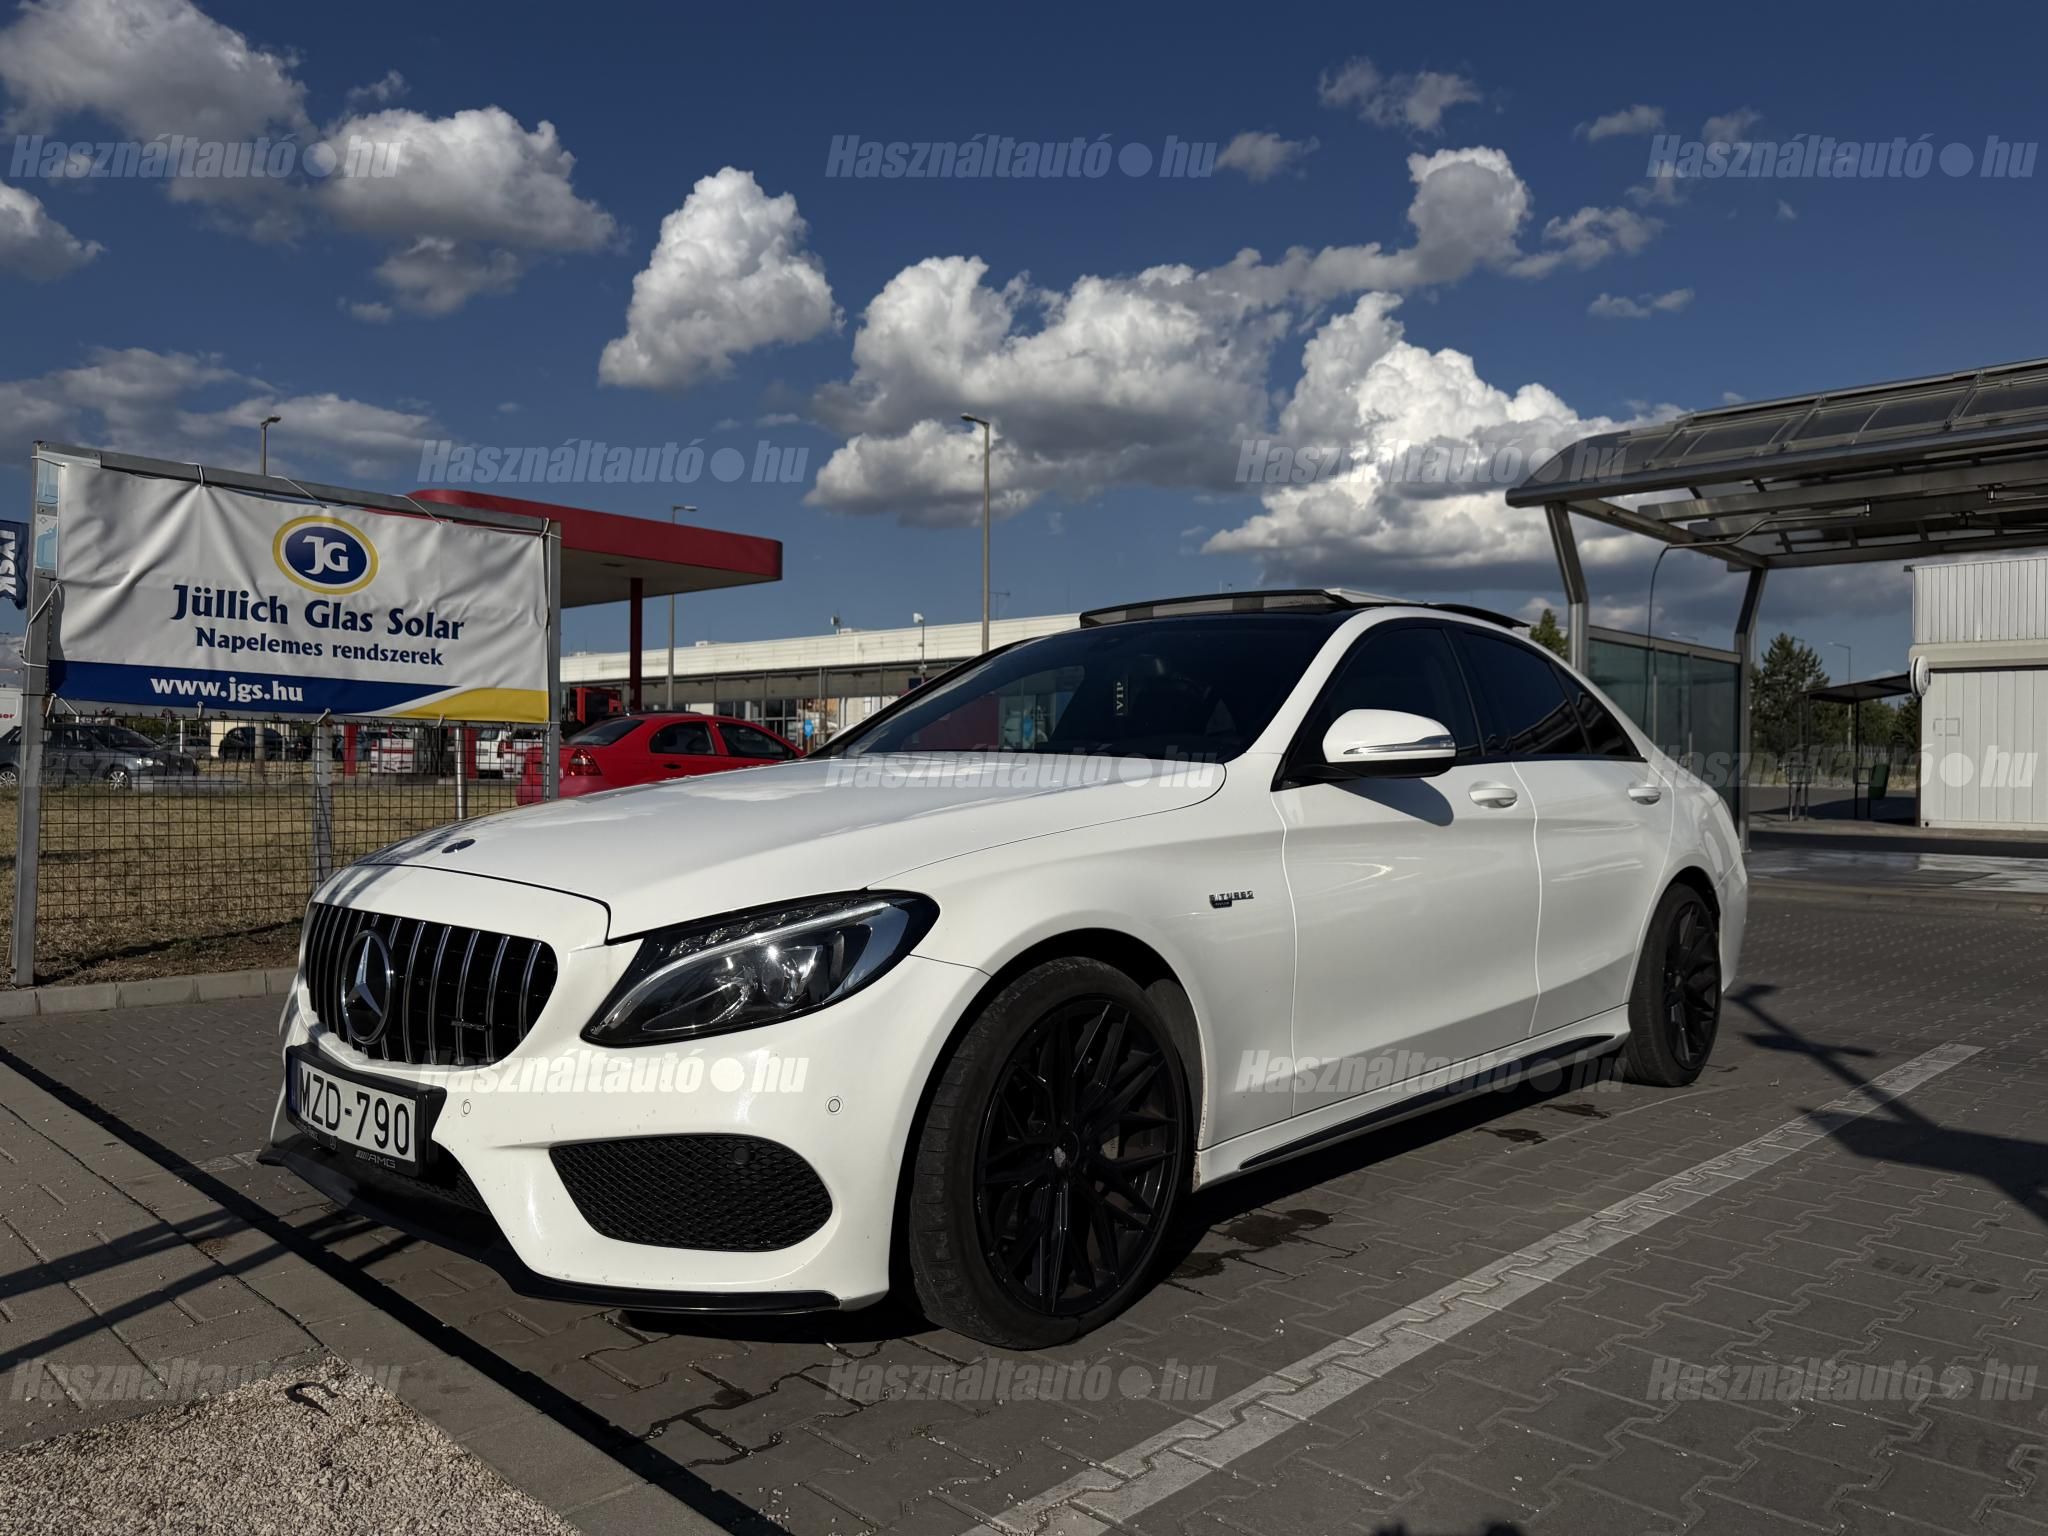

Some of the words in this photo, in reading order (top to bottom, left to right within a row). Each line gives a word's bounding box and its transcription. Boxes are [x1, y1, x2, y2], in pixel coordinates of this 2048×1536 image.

[302, 535, 349, 575] JG
[171, 584, 288, 624] Jüllich
[304, 599, 373, 632] Glas
[387, 608, 465, 640] Solar
[195, 626, 323, 656] Napelemes
[332, 643, 444, 666] rendszerek
[150, 676, 304, 703] www.jgs.hu
[300, 1067, 410, 1156] MZD-790
